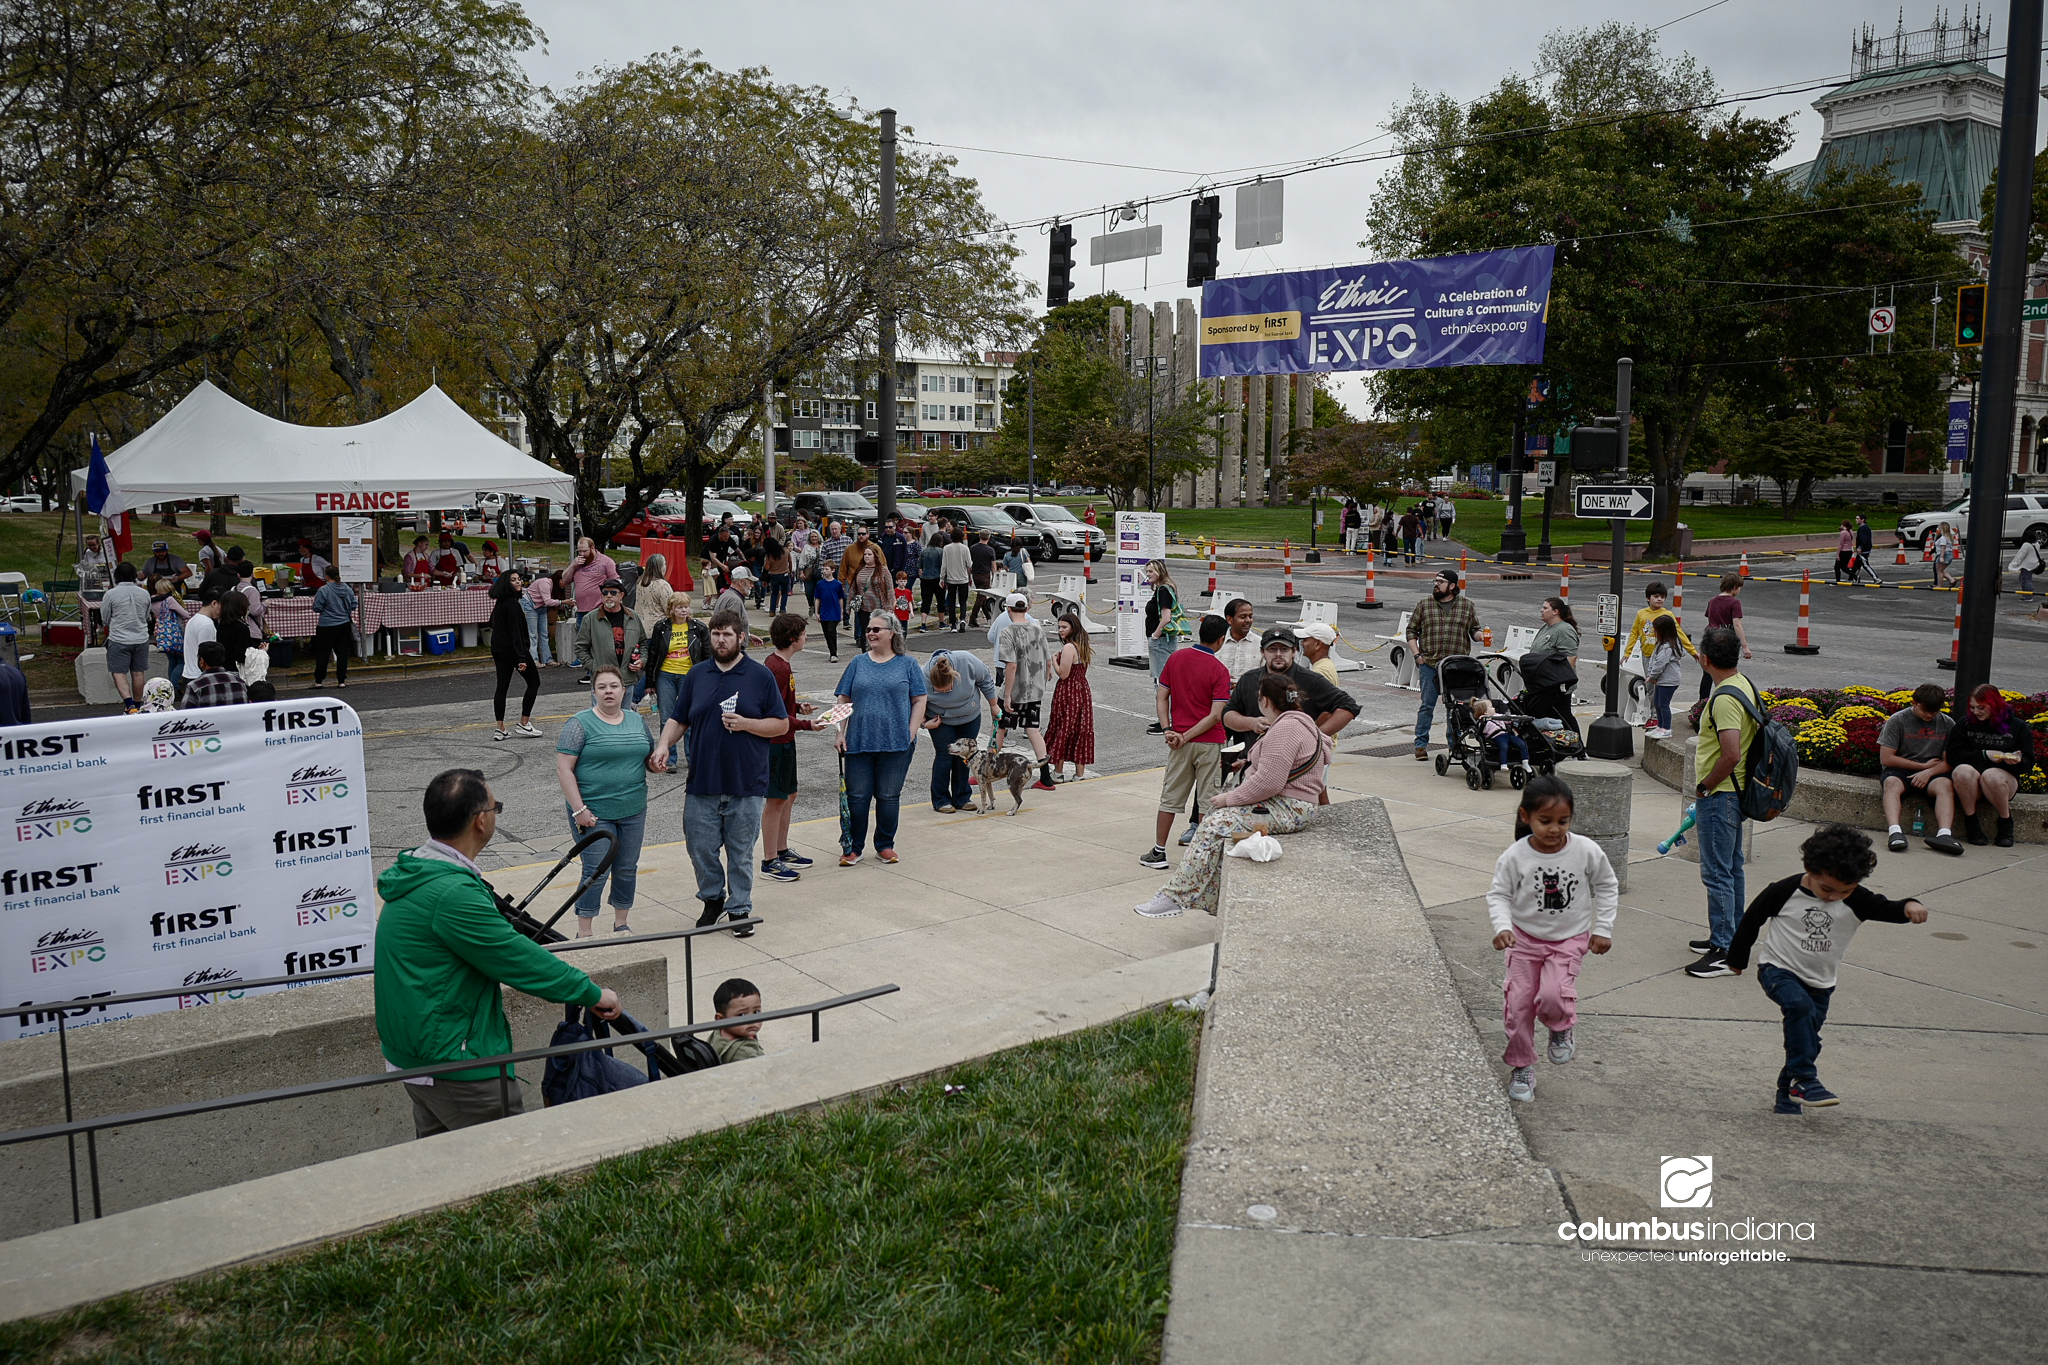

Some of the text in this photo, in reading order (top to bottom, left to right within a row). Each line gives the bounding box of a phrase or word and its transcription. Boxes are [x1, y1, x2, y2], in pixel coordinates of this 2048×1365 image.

[1317, 275, 1408, 311] Ethnic
[1438, 286, 1527, 303] A Celebration of
[1424, 300, 1542, 319] Culture & Community
[2023, 304, 2048, 315] 2nd
[1207, 324, 1260, 336] Sponsored by
[1441, 320, 1527, 336] ethnicexpo.org
[1309, 323, 1417, 364] EXPO
[315, 491, 410, 511] FRANCE
[1584, 496, 1630, 508] ONE WAY
[158, 718, 215, 735] Ethnic
[265, 727, 361, 747] first financial bank
[152, 737, 222, 759] EXPO
[18, 760, 72, 774] financial
[76, 756, 107, 768] bank
[291, 765, 342, 782] Ethnic
[286, 783, 349, 805] EXPO
[22, 797, 84, 816] Ethnic
[139, 803, 246, 825] first financial bank
[16, 816, 93, 842] EXPO
[170, 843, 226, 861] Ethnic
[275, 846, 370, 869] first financial bank
[165, 861, 233, 886] EXPO
[3, 885, 121, 911] first financial bank
[301, 885, 352, 903] Ethnic
[296, 902, 359, 927] EXPO
[37, 928, 98, 947] Ethnic
[152, 926, 257, 952] first financial bank
[1801, 940, 1832, 952] CHAMP
[31, 946, 106, 973] EXPO
[182, 967, 238, 986] Ethnic
